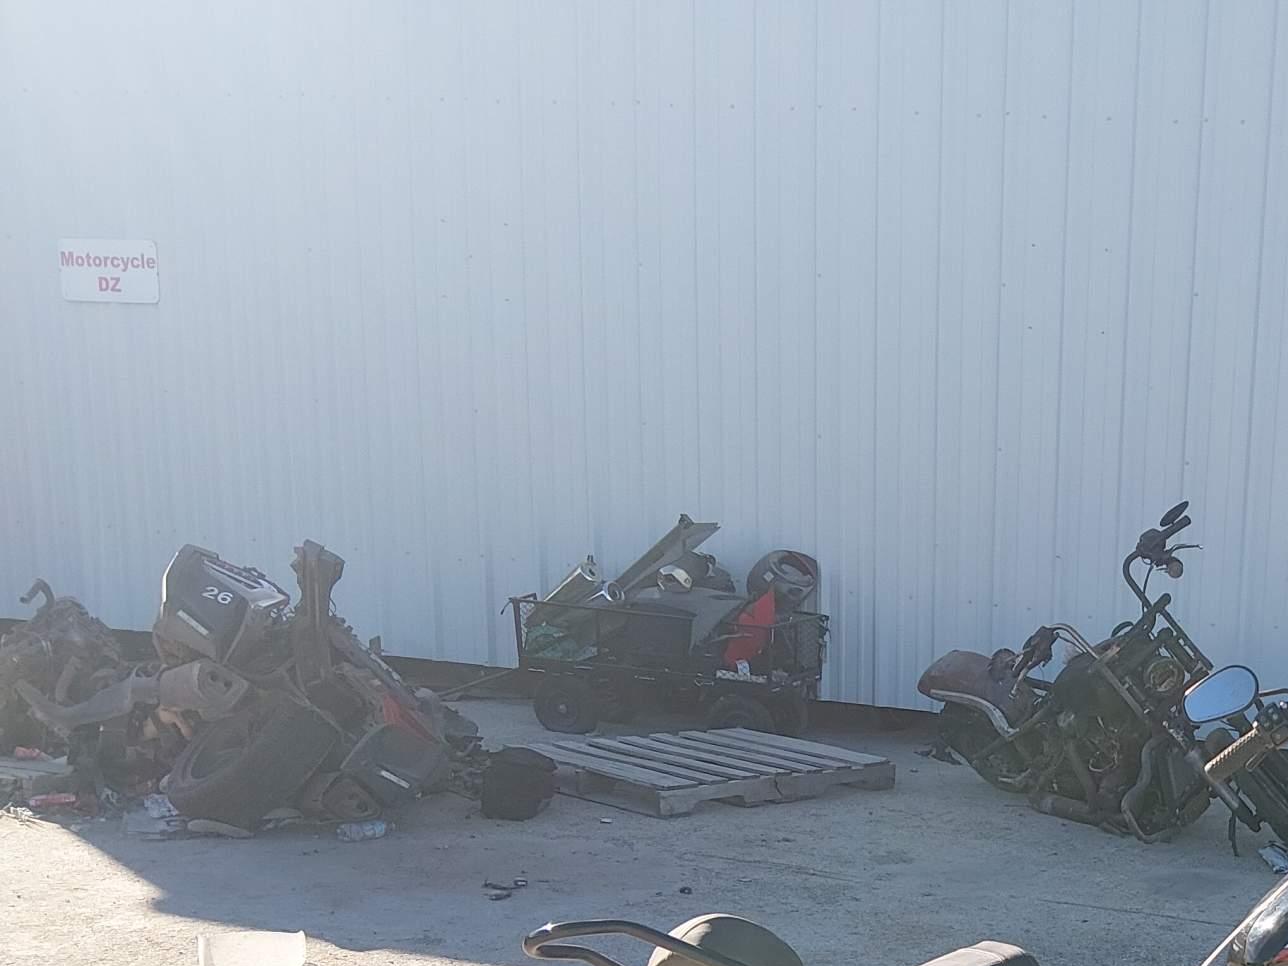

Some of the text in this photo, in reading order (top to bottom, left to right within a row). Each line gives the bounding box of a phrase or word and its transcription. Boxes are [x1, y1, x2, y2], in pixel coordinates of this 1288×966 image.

[60, 251, 156, 272] Motorcycle
[97, 276, 122, 292] DZ
[201, 586, 233, 605] 26
